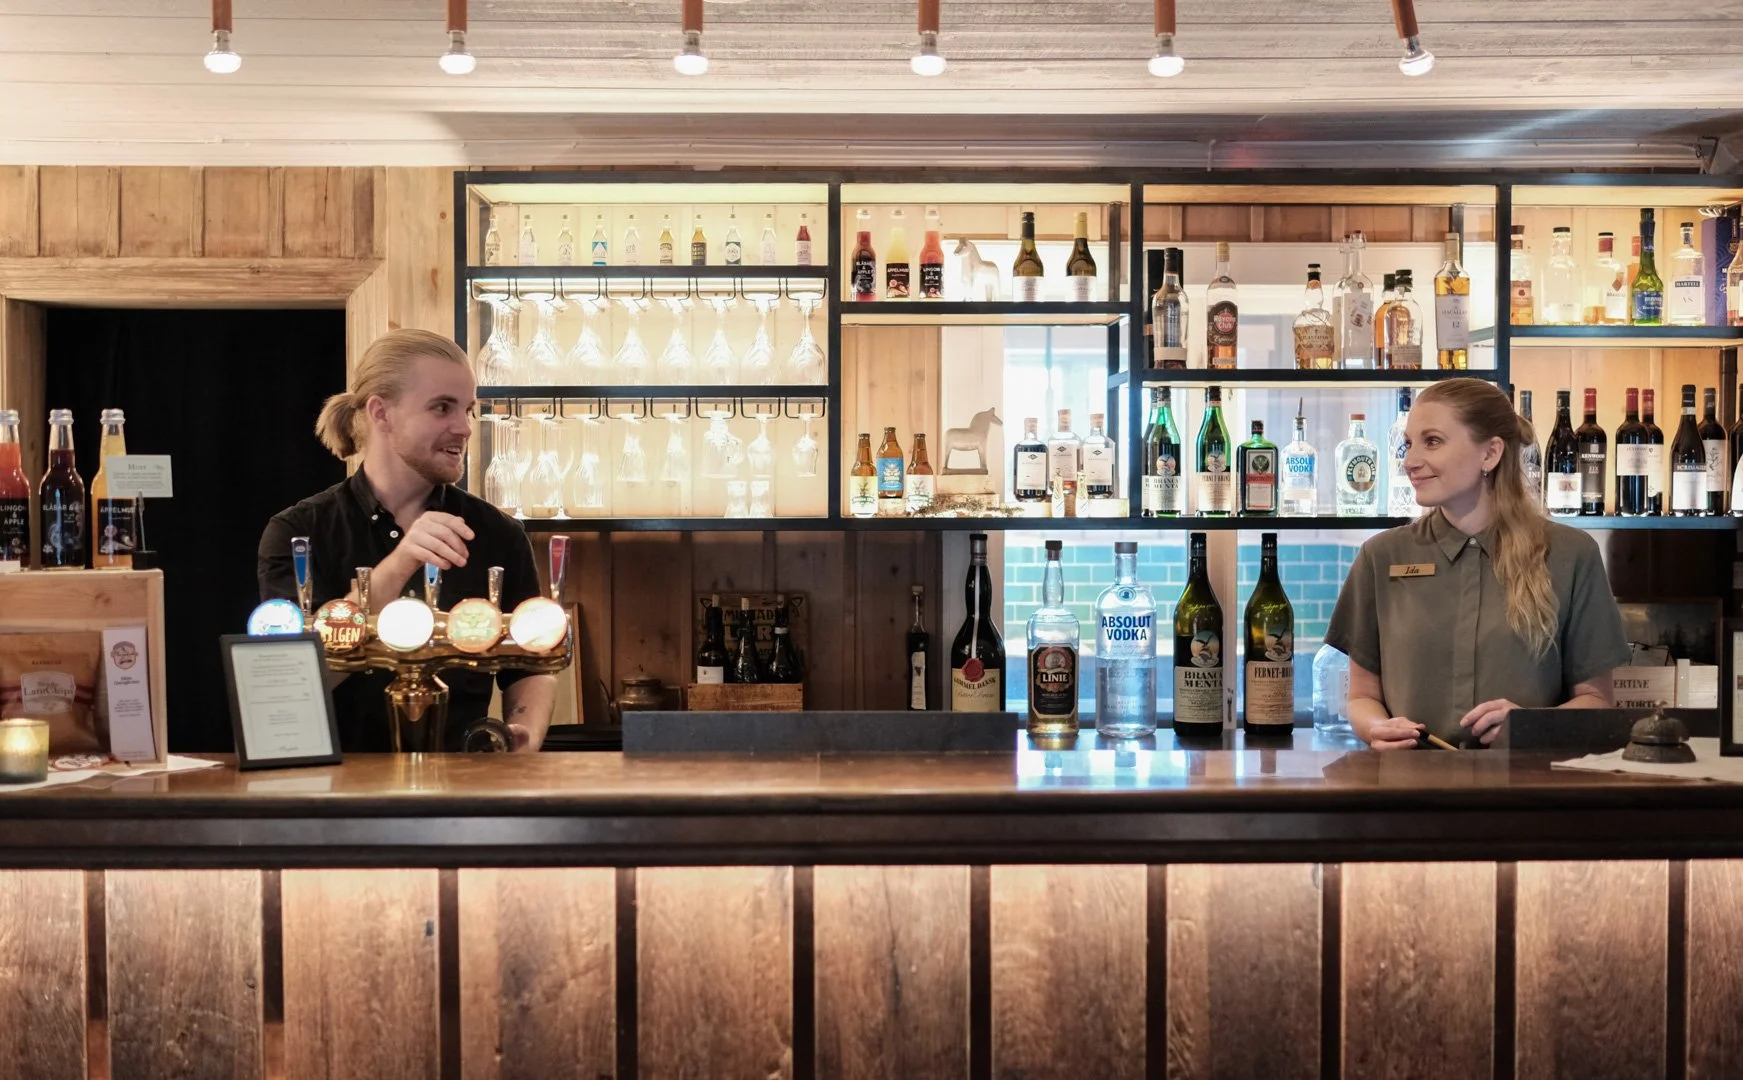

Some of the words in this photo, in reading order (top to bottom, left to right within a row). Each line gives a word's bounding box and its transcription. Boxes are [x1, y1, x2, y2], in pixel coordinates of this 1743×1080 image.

[1405, 566, 1419, 575] Ida
[1101, 615, 1151, 629] ABSOLUT
[1106, 628, 1148, 641] VODKA
[1042, 674, 1068, 682] LINIE
